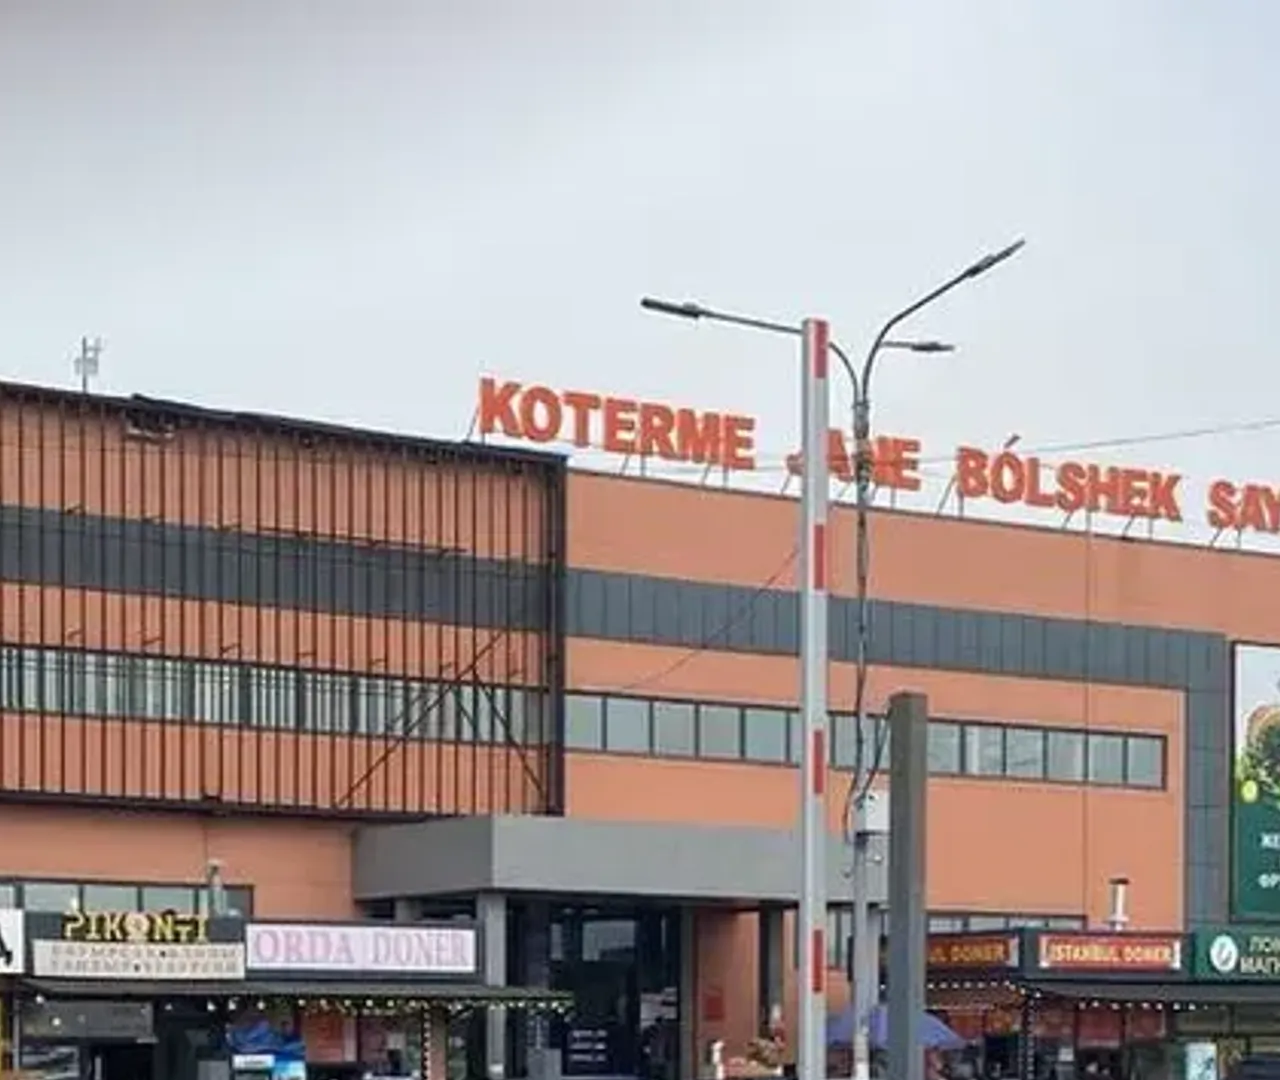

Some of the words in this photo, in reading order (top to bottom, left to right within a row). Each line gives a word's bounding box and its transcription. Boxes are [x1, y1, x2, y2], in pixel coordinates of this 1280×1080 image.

[480, 378, 756, 471] KOTERME
[256, 929, 356, 964] ORDA
[372, 932, 468, 967] DONER
